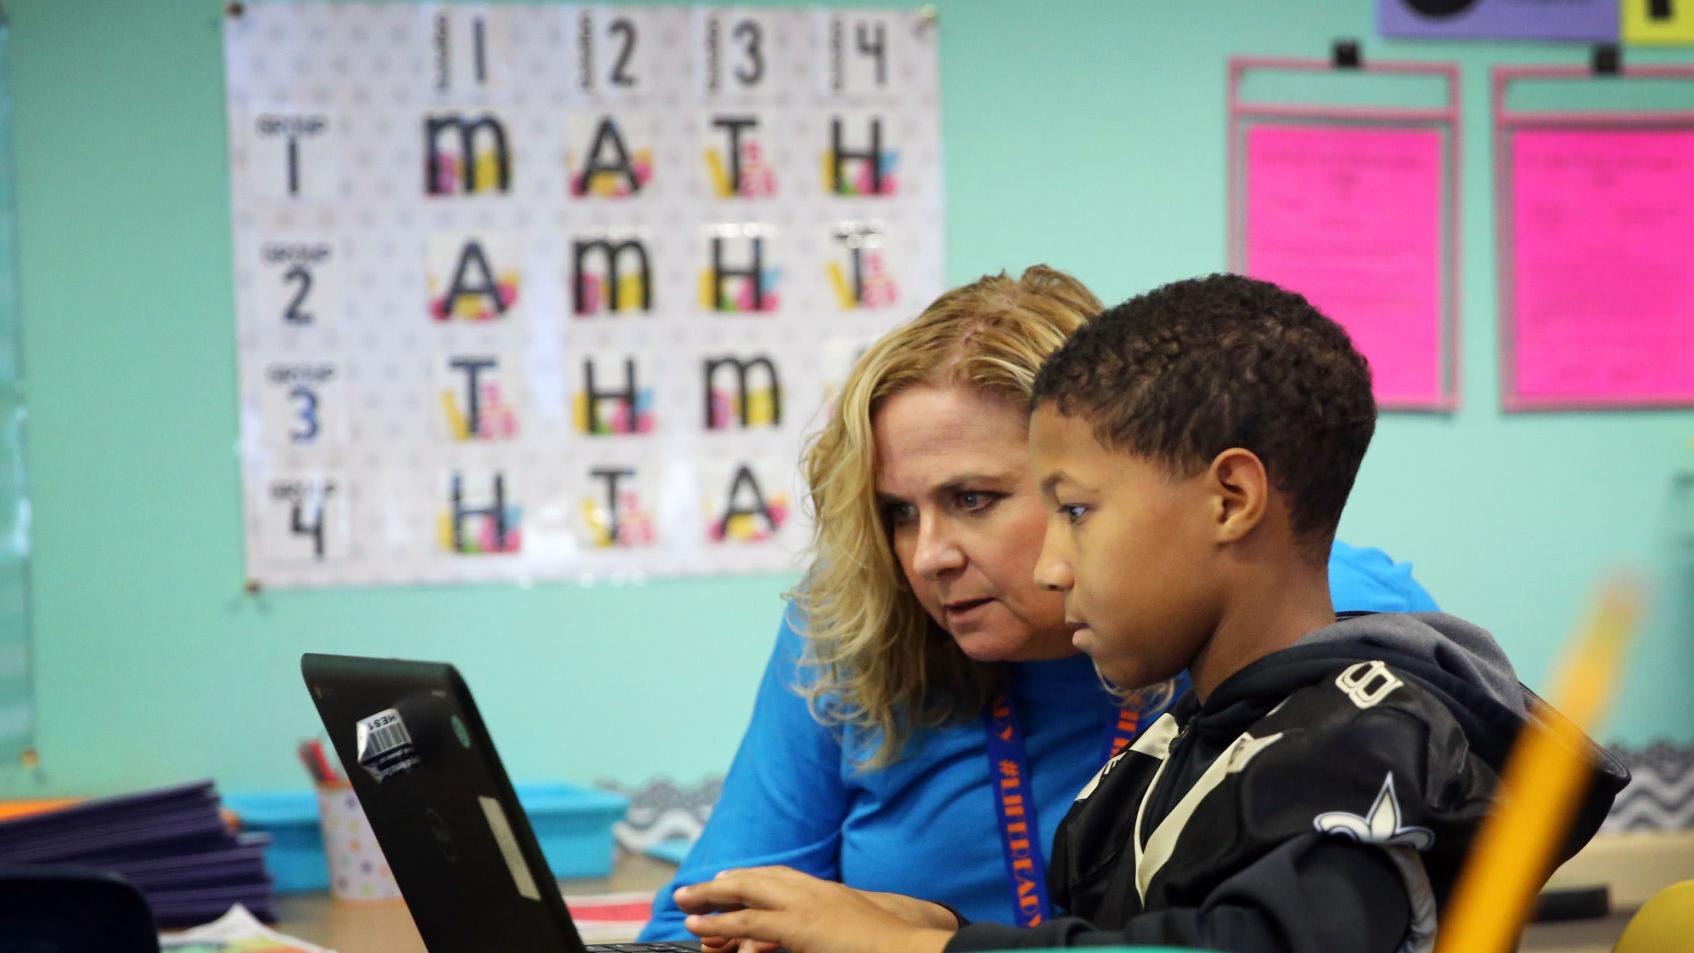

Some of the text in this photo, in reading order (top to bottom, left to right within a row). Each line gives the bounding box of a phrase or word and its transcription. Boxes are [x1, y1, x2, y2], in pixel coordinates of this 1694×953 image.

[607, 18, 638, 86] 2
[731, 20, 765, 86] 3
[855, 20, 886, 85] 4
[580, 116, 641, 195] A
[711, 116, 758, 194] T
[830, 116, 882, 195] H
[282, 264, 313, 324] 2
[443, 240, 511, 318] A
[711, 234, 765, 312] H
[289, 387, 319, 441] 3
[449, 357, 496, 436] T
[584, 356, 637, 433] H
[290, 465, 778, 559] 4 H T A
